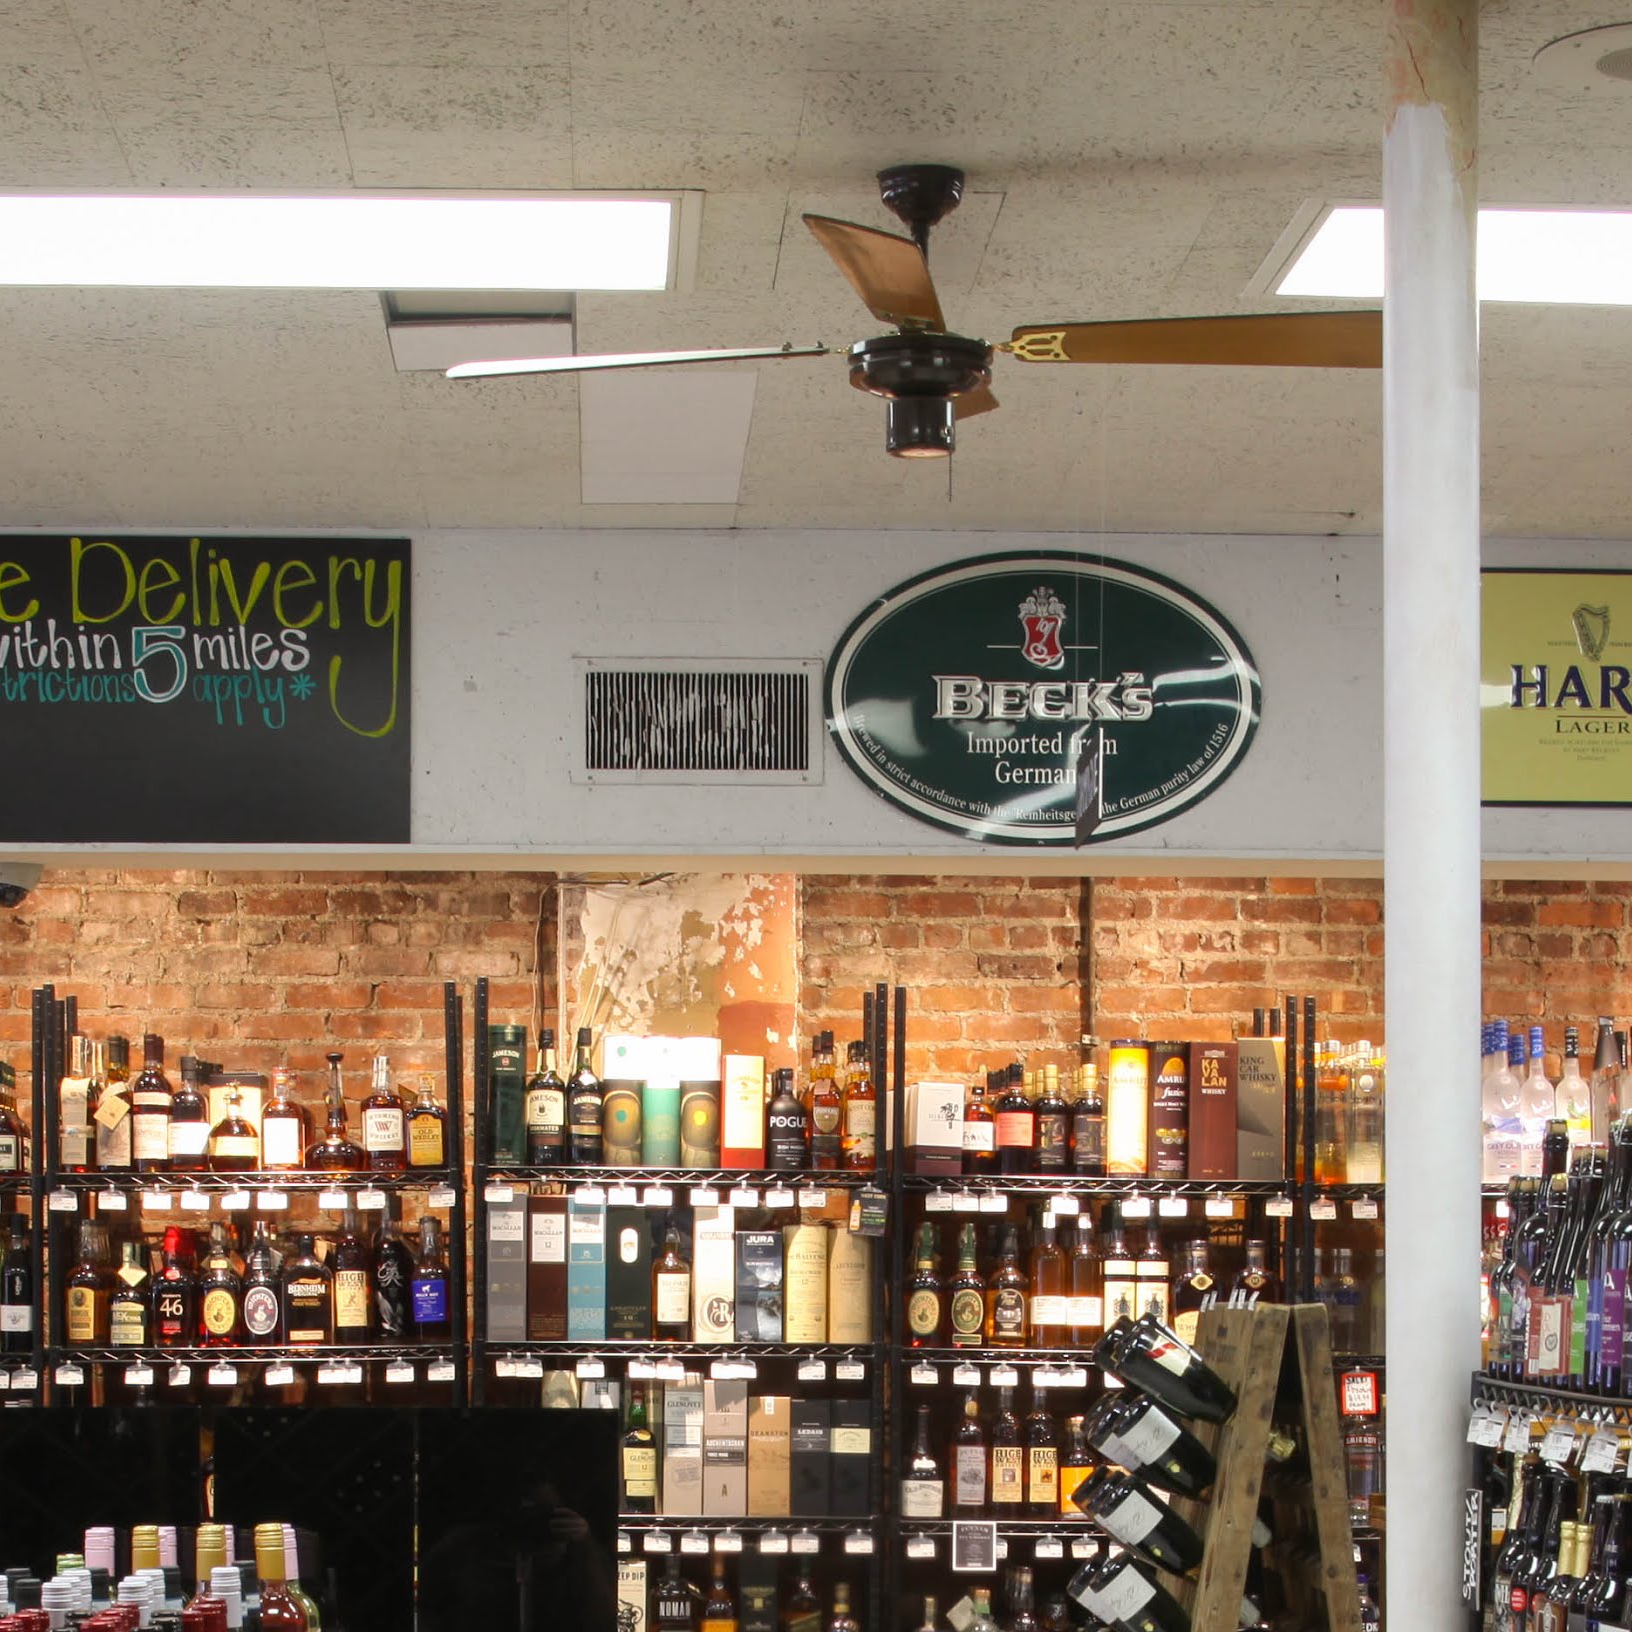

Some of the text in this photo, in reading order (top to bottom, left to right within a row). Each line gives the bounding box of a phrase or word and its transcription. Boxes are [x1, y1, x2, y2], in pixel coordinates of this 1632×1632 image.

[70, 538, 402, 738] Delivery
[131, 625, 187, 703] 5
[193, 624, 310, 671] miles
[1556, 719, 1631, 734] LAGER
[967, 731, 1063, 756] Imported
[876, 749, 887, 763] in
[886, 758, 910, 785] strict
[910, 779, 967, 810] accordance
[969, 802, 992, 818] with
[1119, 787, 1160, 810] German
[1161, 771, 1189, 795] purity
[1186, 759, 1206, 780] law
[1203, 749, 1215, 765] of
[1212, 723, 1230, 751] 1516
[492, 1050, 520, 1058] JAMESON
[1202, 1059, 1218, 1069] KA
[1202, 1069, 1219, 1077] VA
[1240, 1073, 1276, 1082] WHISKY
[1202, 1078, 1226, 1086] LAN
[746, 1236, 774, 1245] JURA
[337, 1273, 365, 1281] HIGH
[160, 1297, 183, 1317] 46
[632, 1572, 644, 1581] DIP
[659, 1601, 691, 1617] NOMAD
